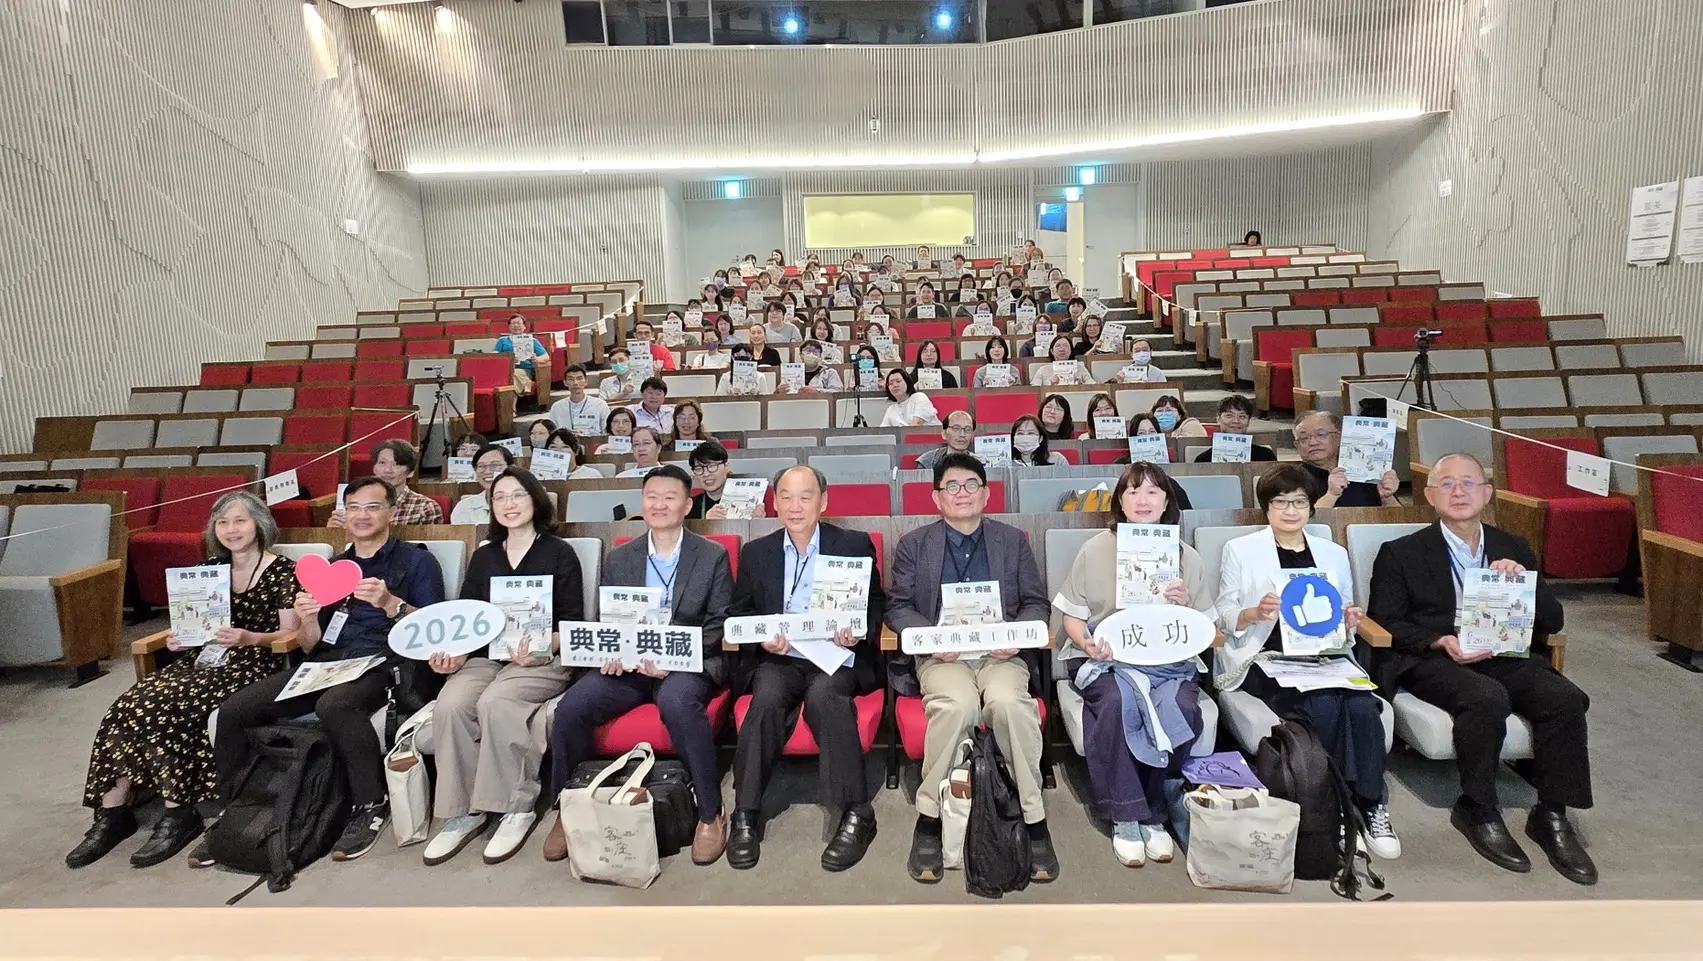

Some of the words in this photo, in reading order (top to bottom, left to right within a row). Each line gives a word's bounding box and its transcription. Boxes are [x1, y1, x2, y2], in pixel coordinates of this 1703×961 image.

[404, 610, 490, 650] 2026
[731, 618, 862, 636] 典藏管理論壇
[1121, 620, 1188, 649] 成功
